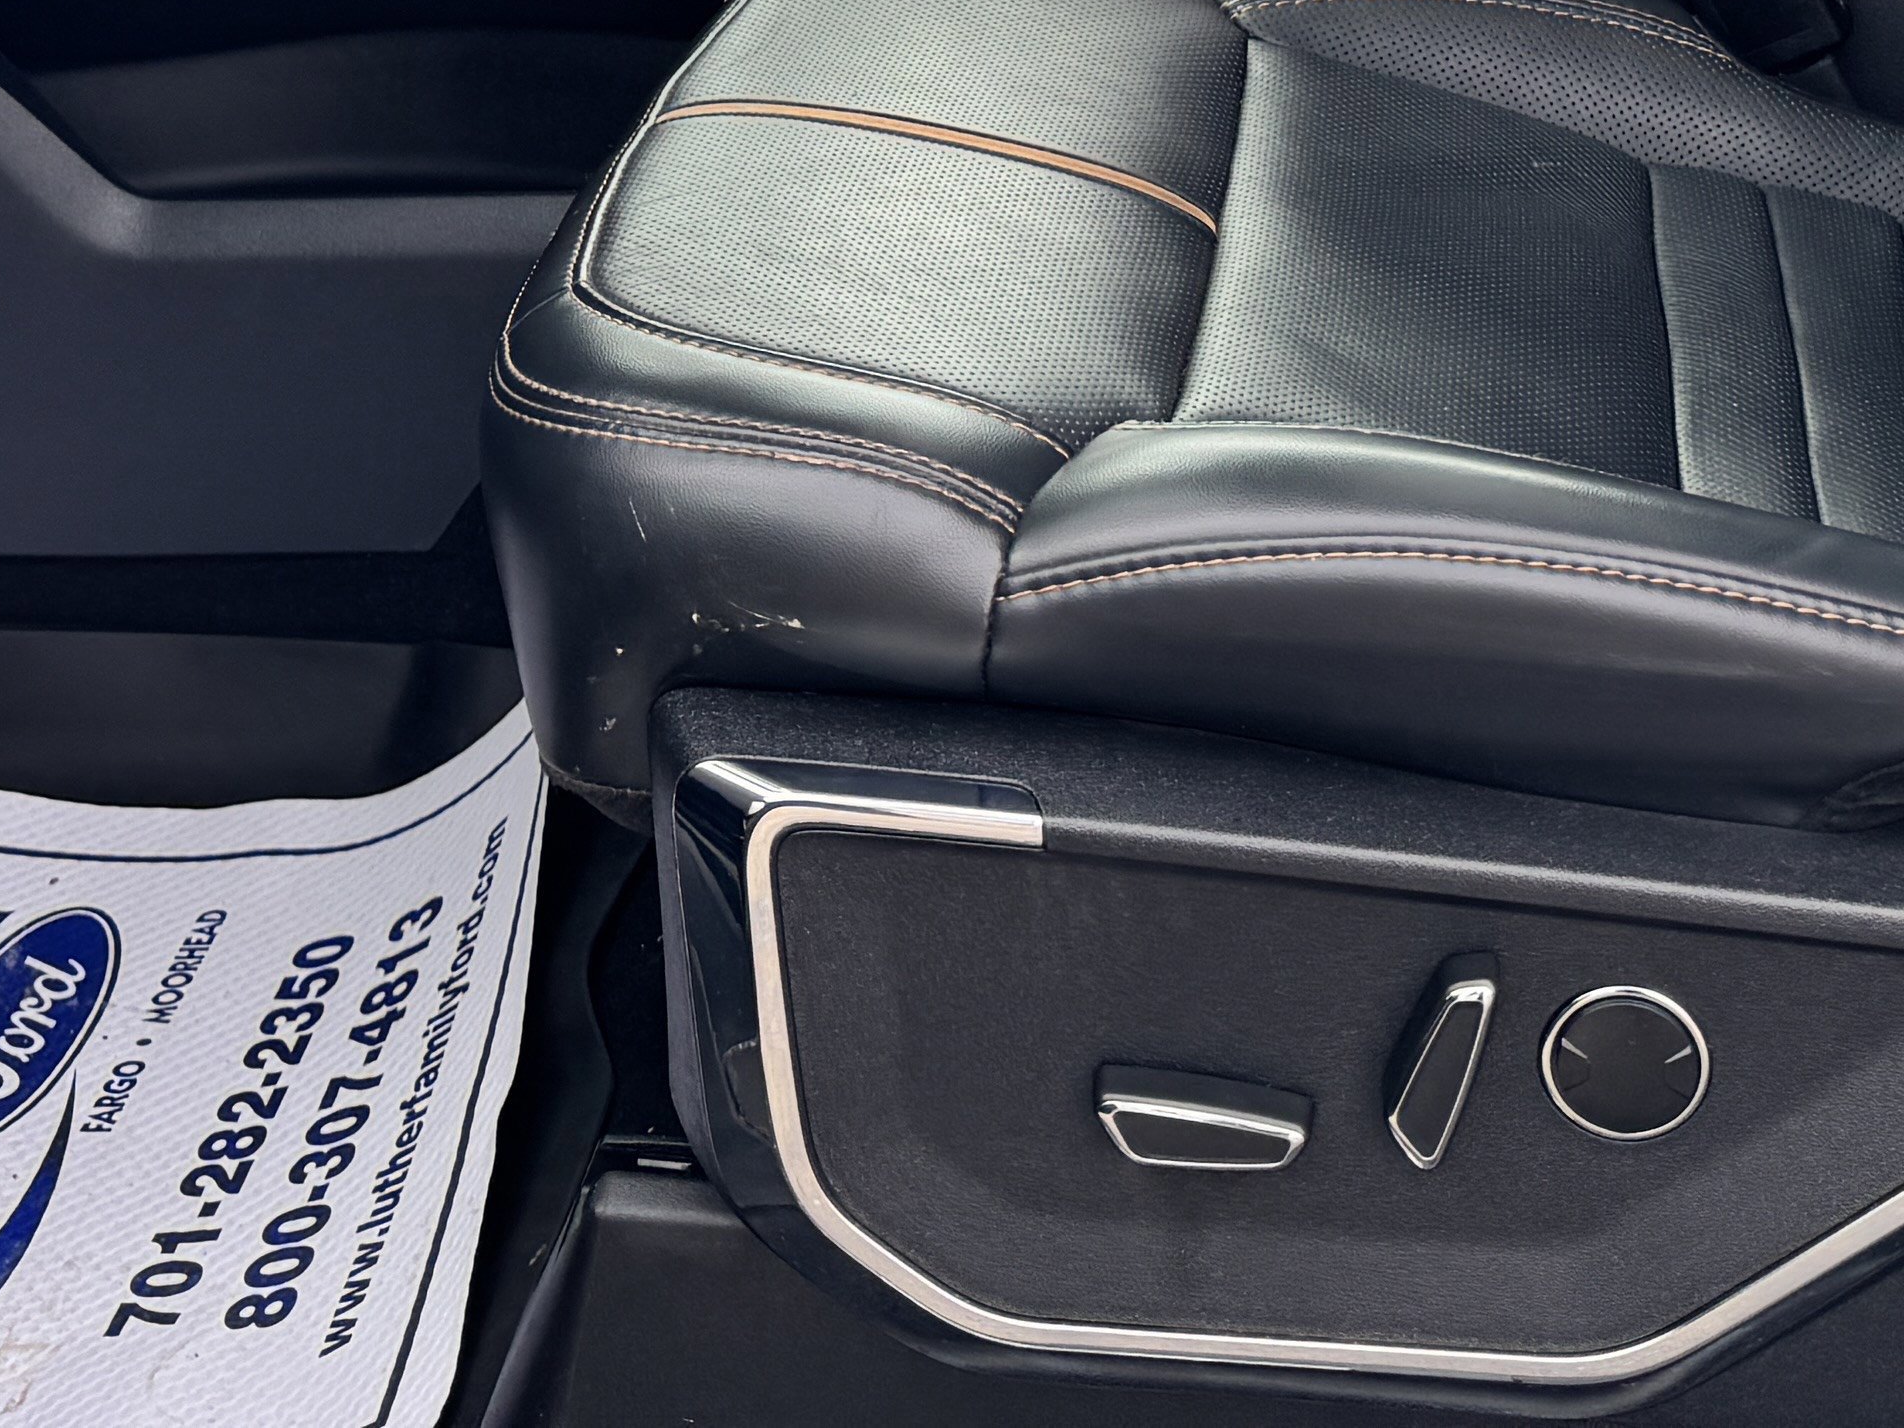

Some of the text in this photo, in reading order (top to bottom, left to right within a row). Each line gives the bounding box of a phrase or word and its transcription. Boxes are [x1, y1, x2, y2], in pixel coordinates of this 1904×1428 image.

[80, 909, 228, 1133] FARGO MOORHEAD
[103, 935, 355, 1338] 701-282-2350
[224, 895, 444, 1330] 800-307-4813
[318, 816, 509, 1359] www.lutherfamilyford.com
